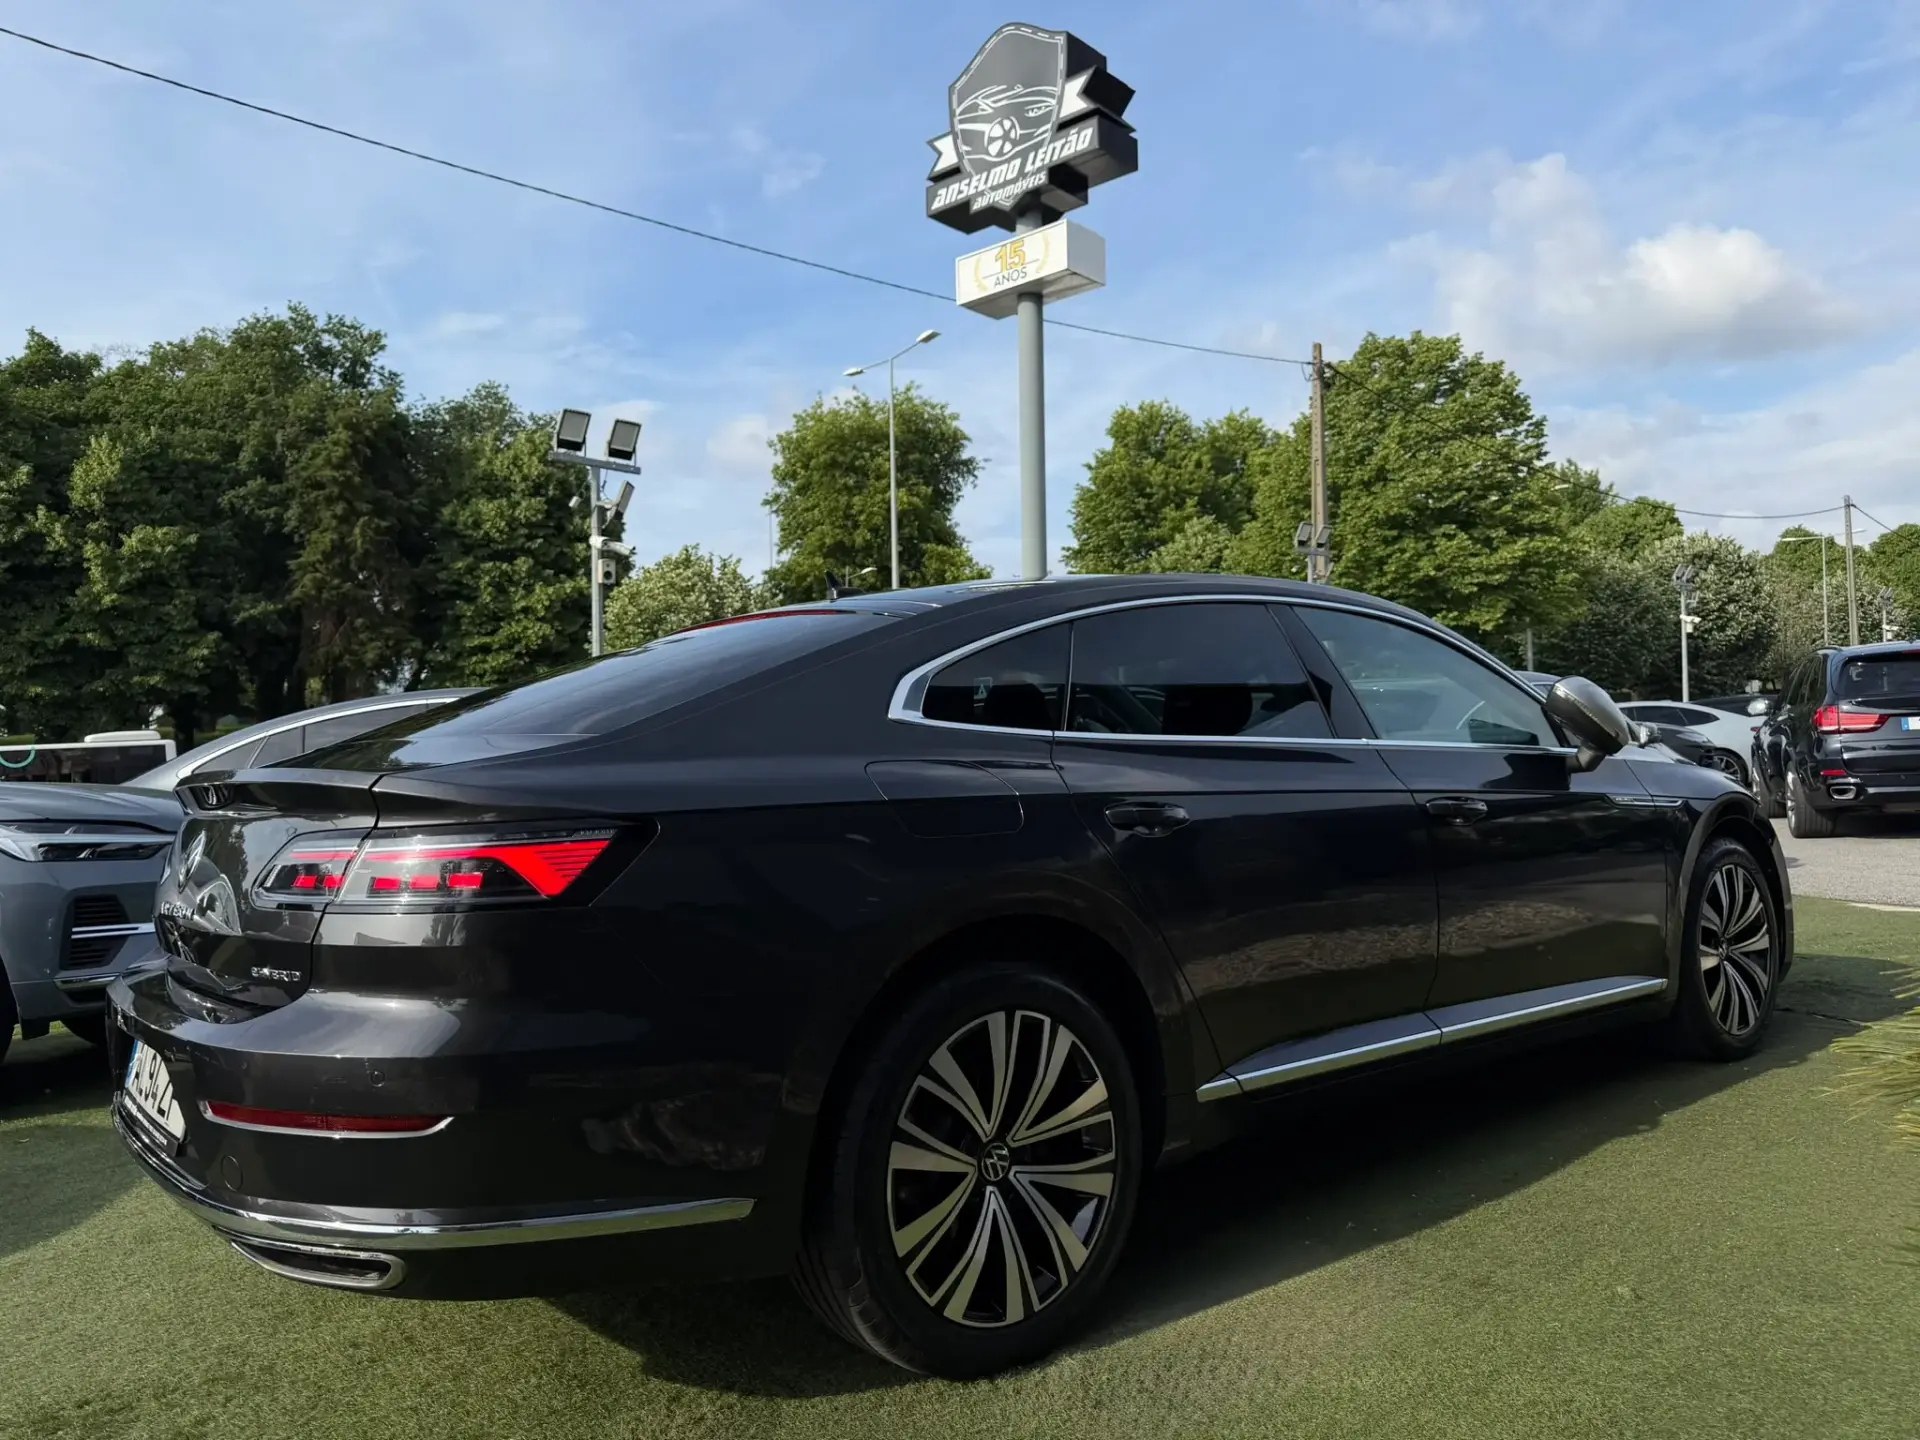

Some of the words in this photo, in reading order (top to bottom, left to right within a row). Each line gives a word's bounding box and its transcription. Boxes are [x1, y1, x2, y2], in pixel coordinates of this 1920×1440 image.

[1024, 126, 1094, 173] LEITÃO
[995, 239, 1026, 273] 15
[993, 266, 1027, 288] ANOS
